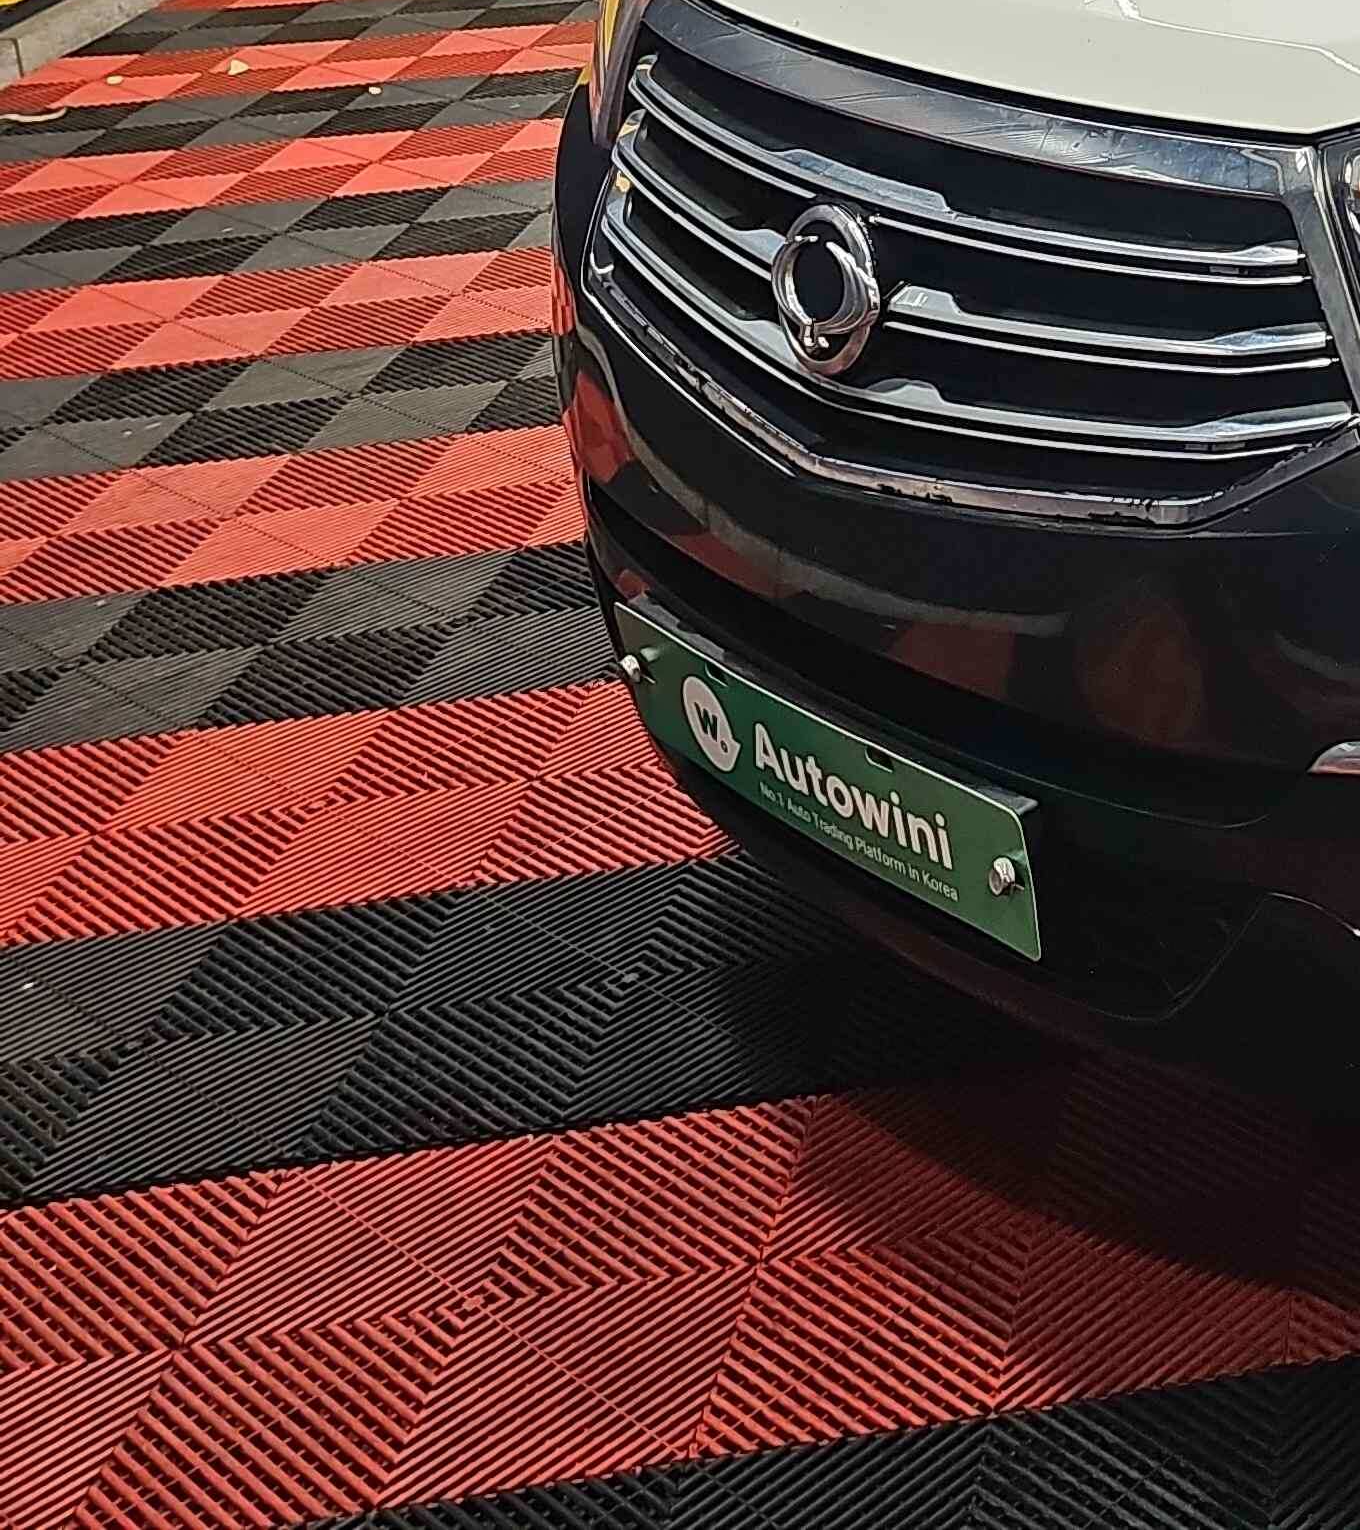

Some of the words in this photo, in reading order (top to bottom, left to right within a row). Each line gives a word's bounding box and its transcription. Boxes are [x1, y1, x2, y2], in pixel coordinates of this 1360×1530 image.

[755, 722, 953, 870] Autowini
[787, 798, 812, 823] Auto
[812, 812, 855, 850] Trading
[854, 836, 907, 876] Platform
[921, 870, 959, 902] Korea
